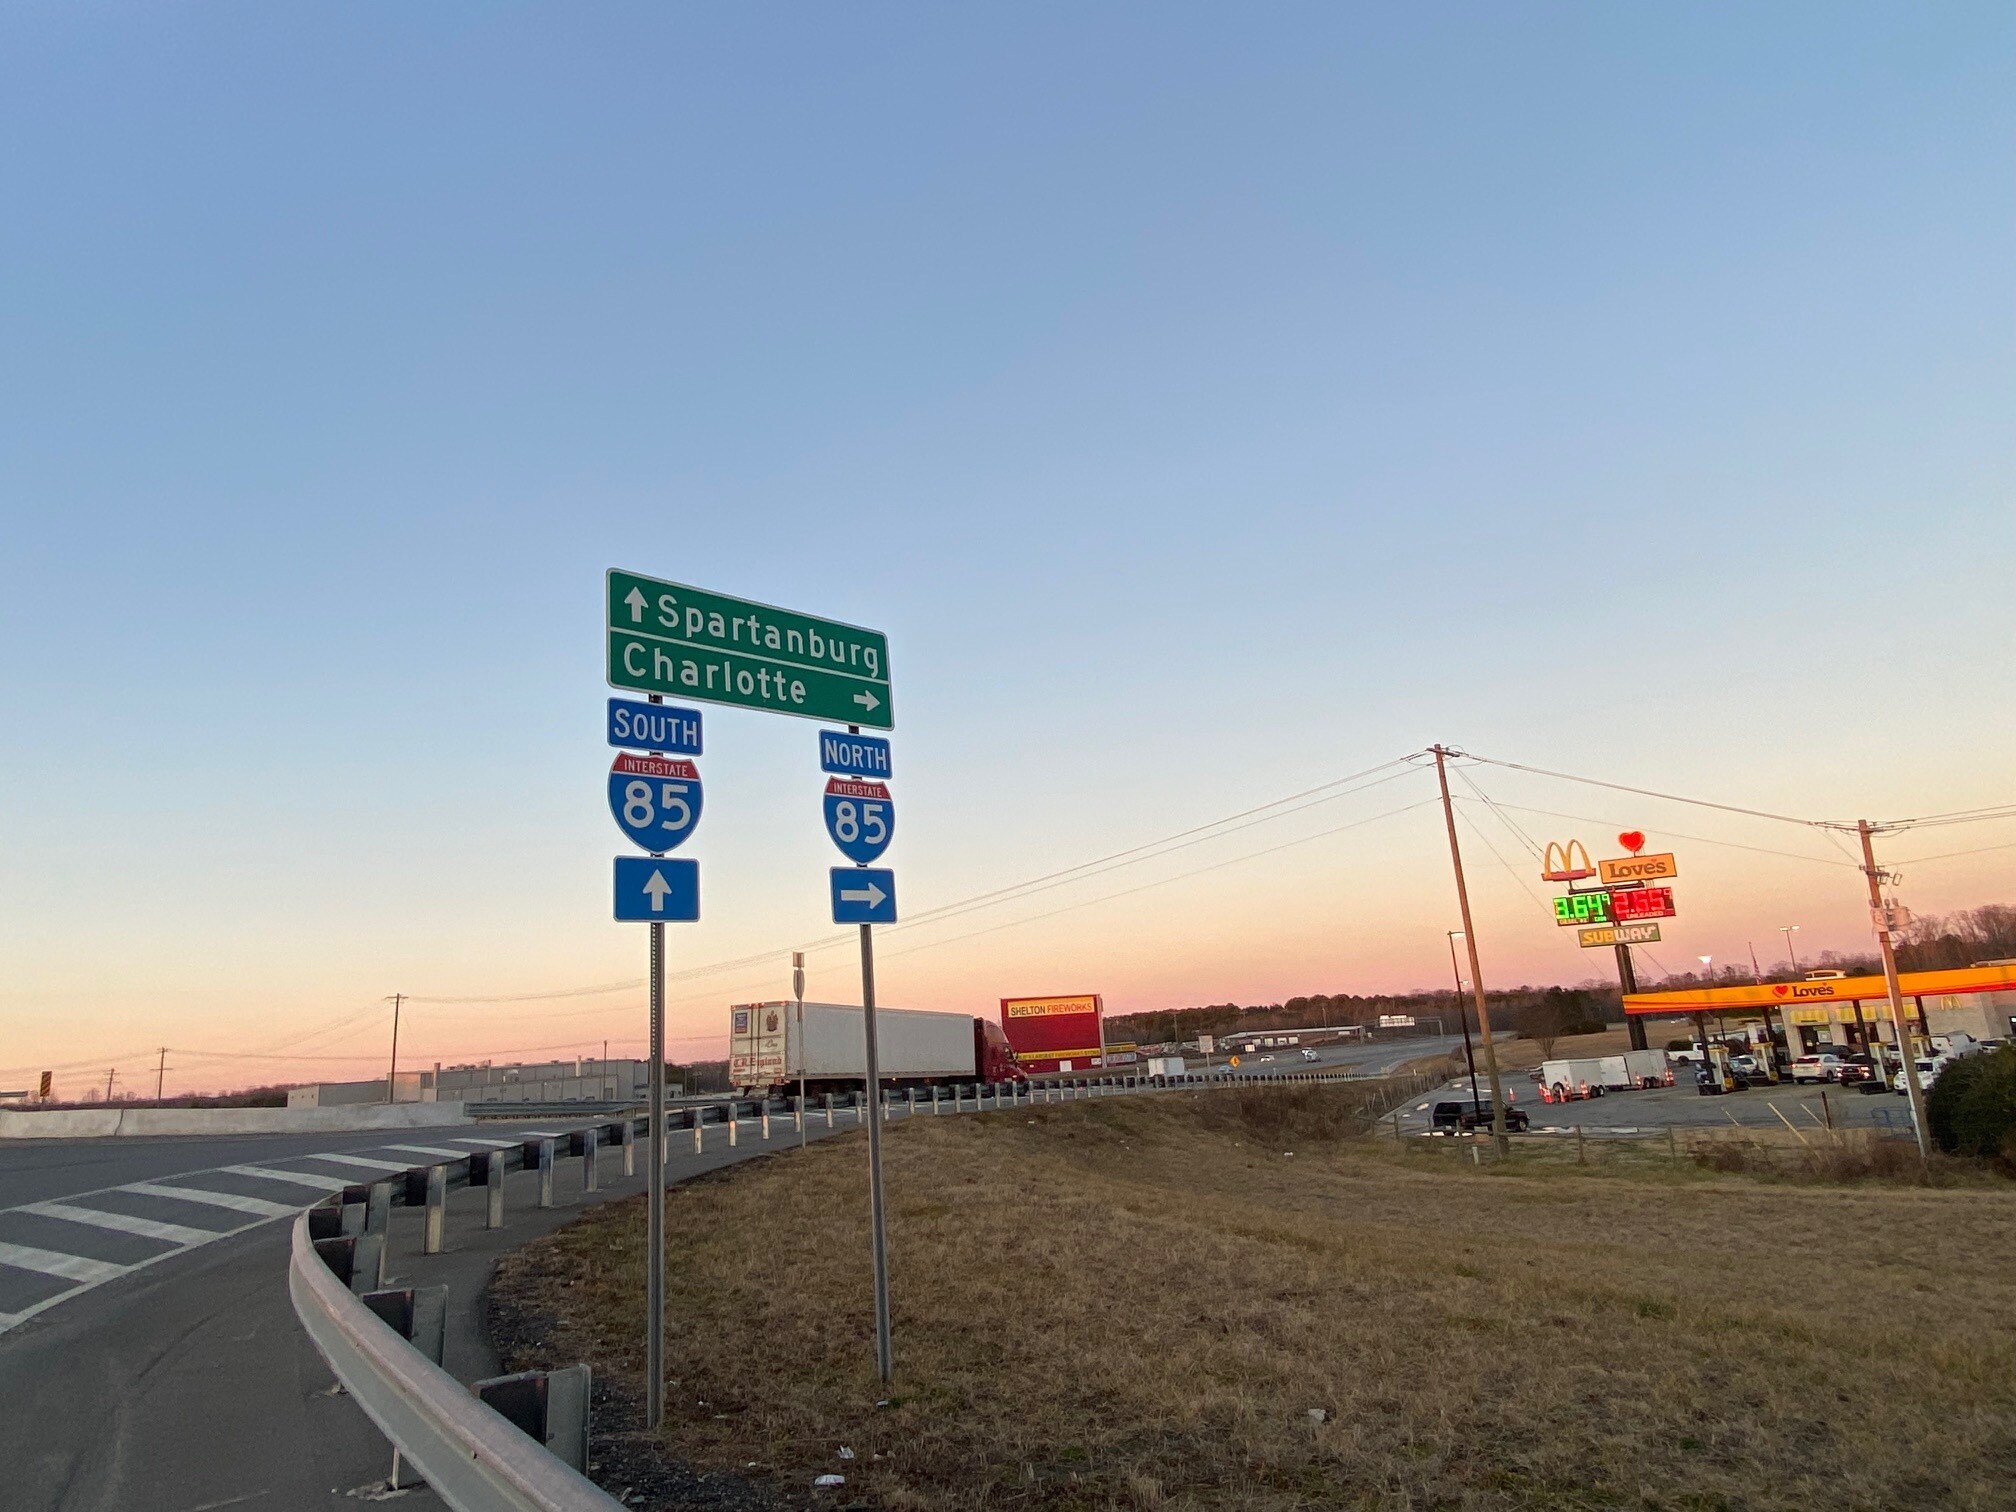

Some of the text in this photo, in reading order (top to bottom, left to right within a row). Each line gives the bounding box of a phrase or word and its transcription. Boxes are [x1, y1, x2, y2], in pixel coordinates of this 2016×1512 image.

[658, 594, 878, 678] Spartanburg
[623, 642, 807, 704] Charlotte
[614, 707, 698, 747] SOUTH
[624, 758, 688, 777] INTERSTATE
[825, 738, 887, 771] NORTH
[623, 780, 692, 831] 85
[833, 782, 882, 798] INTERSTATE
[835, 801, 887, 845] 85
[1582, 926, 1656, 944] SUBWAY
[1010, 1003, 1093, 1016] SHELTON FIREWORKS
